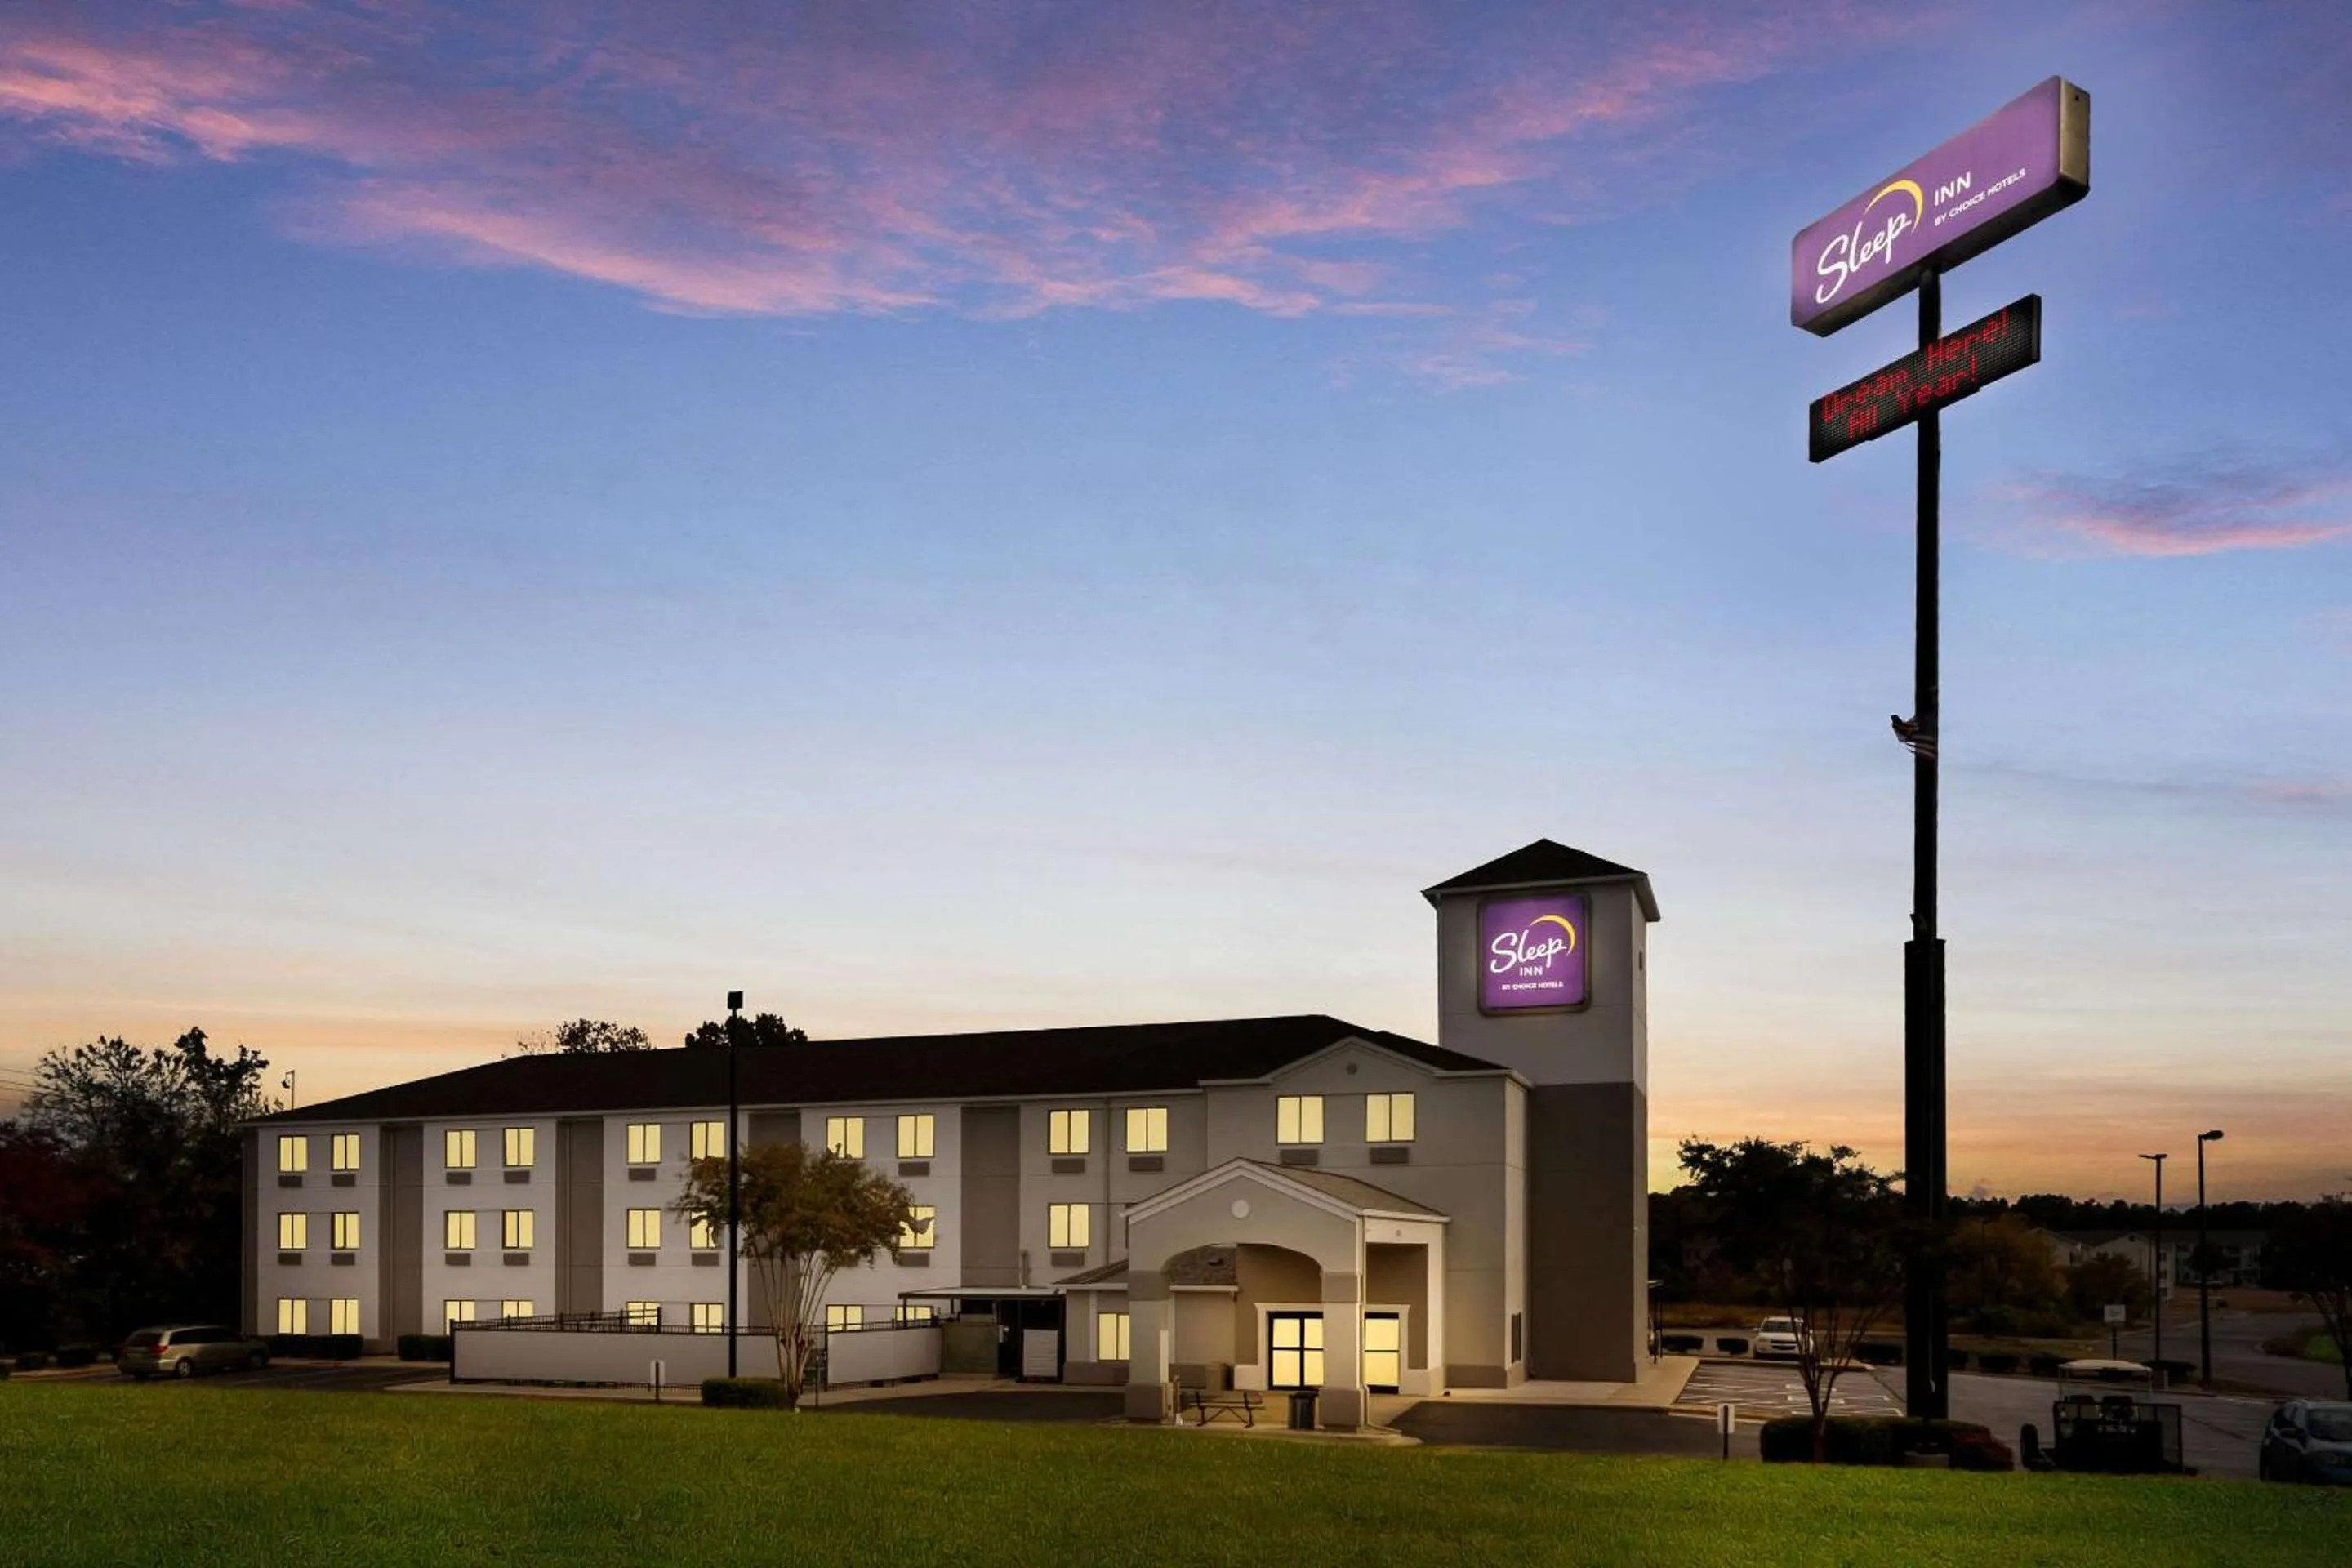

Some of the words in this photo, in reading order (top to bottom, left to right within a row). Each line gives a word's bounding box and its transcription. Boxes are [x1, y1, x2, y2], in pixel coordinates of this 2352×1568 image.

[1934, 172, 1971, 206] INN
[1934, 213, 1947, 226] BY
[1949, 191, 1985, 217] CHOICE
[1987, 168, 2025, 196] HOTELS
[1815, 213, 1912, 305] Sleep
[1822, 369, 1909, 424] Dream
[1926, 308, 2009, 371] Here!
[1896, 354, 1977, 413] Year!
[1490, 929, 1567, 973] Sleep
[1519, 966, 1543, 976] INN
